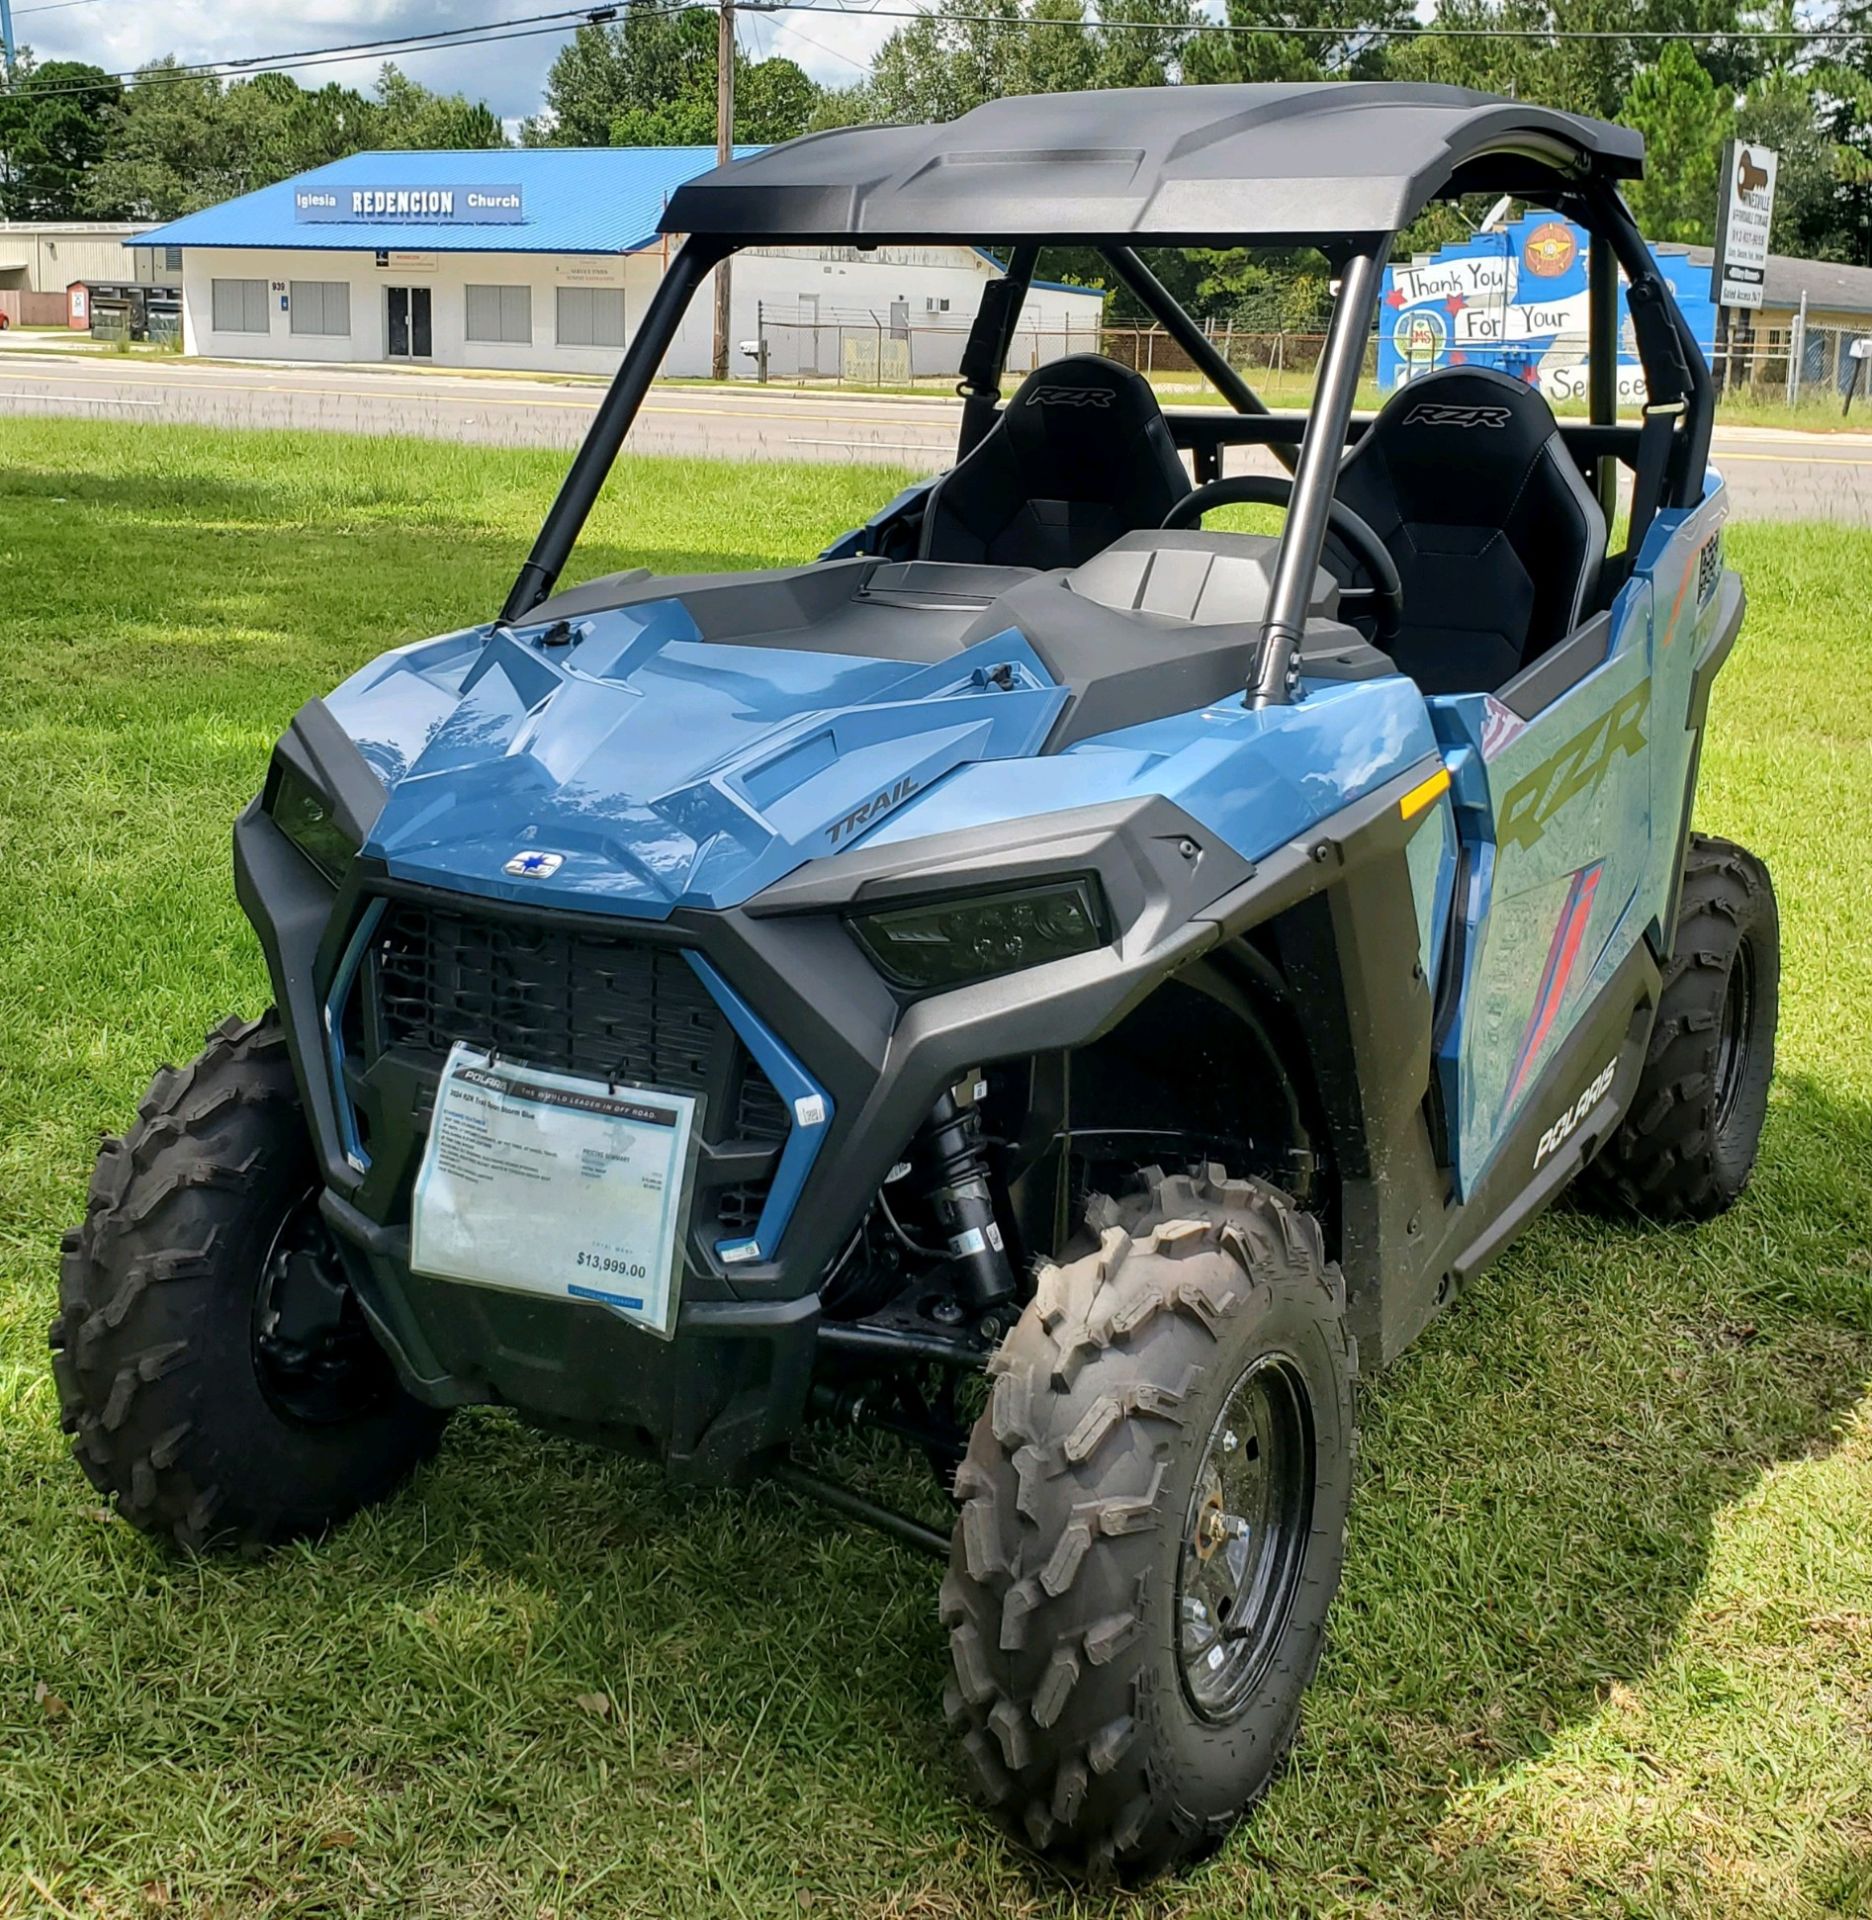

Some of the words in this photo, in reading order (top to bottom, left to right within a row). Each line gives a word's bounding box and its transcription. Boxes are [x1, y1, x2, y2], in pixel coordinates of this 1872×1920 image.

[297, 193, 337, 209] Iglesia
[352, 191, 453, 214] REDENCION
[467, 193, 520, 208] Church
[1396, 267, 1463, 299] Thank
[1467, 263, 1503, 289] You
[1466, 310, 1501, 337] For
[1521, 306, 1570, 333] Your
[1025, 385, 1117, 408] RZR
[1550, 369, 1645, 401] Sece
[1402, 403, 1512, 428] RZR
[1496, 676, 1651, 862] RZR
[825, 775, 920, 845] TRAIL
[569, 1097, 600, 1109] LEADER
[602, 1102, 612, 1111] IN
[613, 1105, 630, 1114] OFF
[1533, 1056, 1618, 1170] POLARIS
[577, 1251, 646, 1278] $13,999.00
